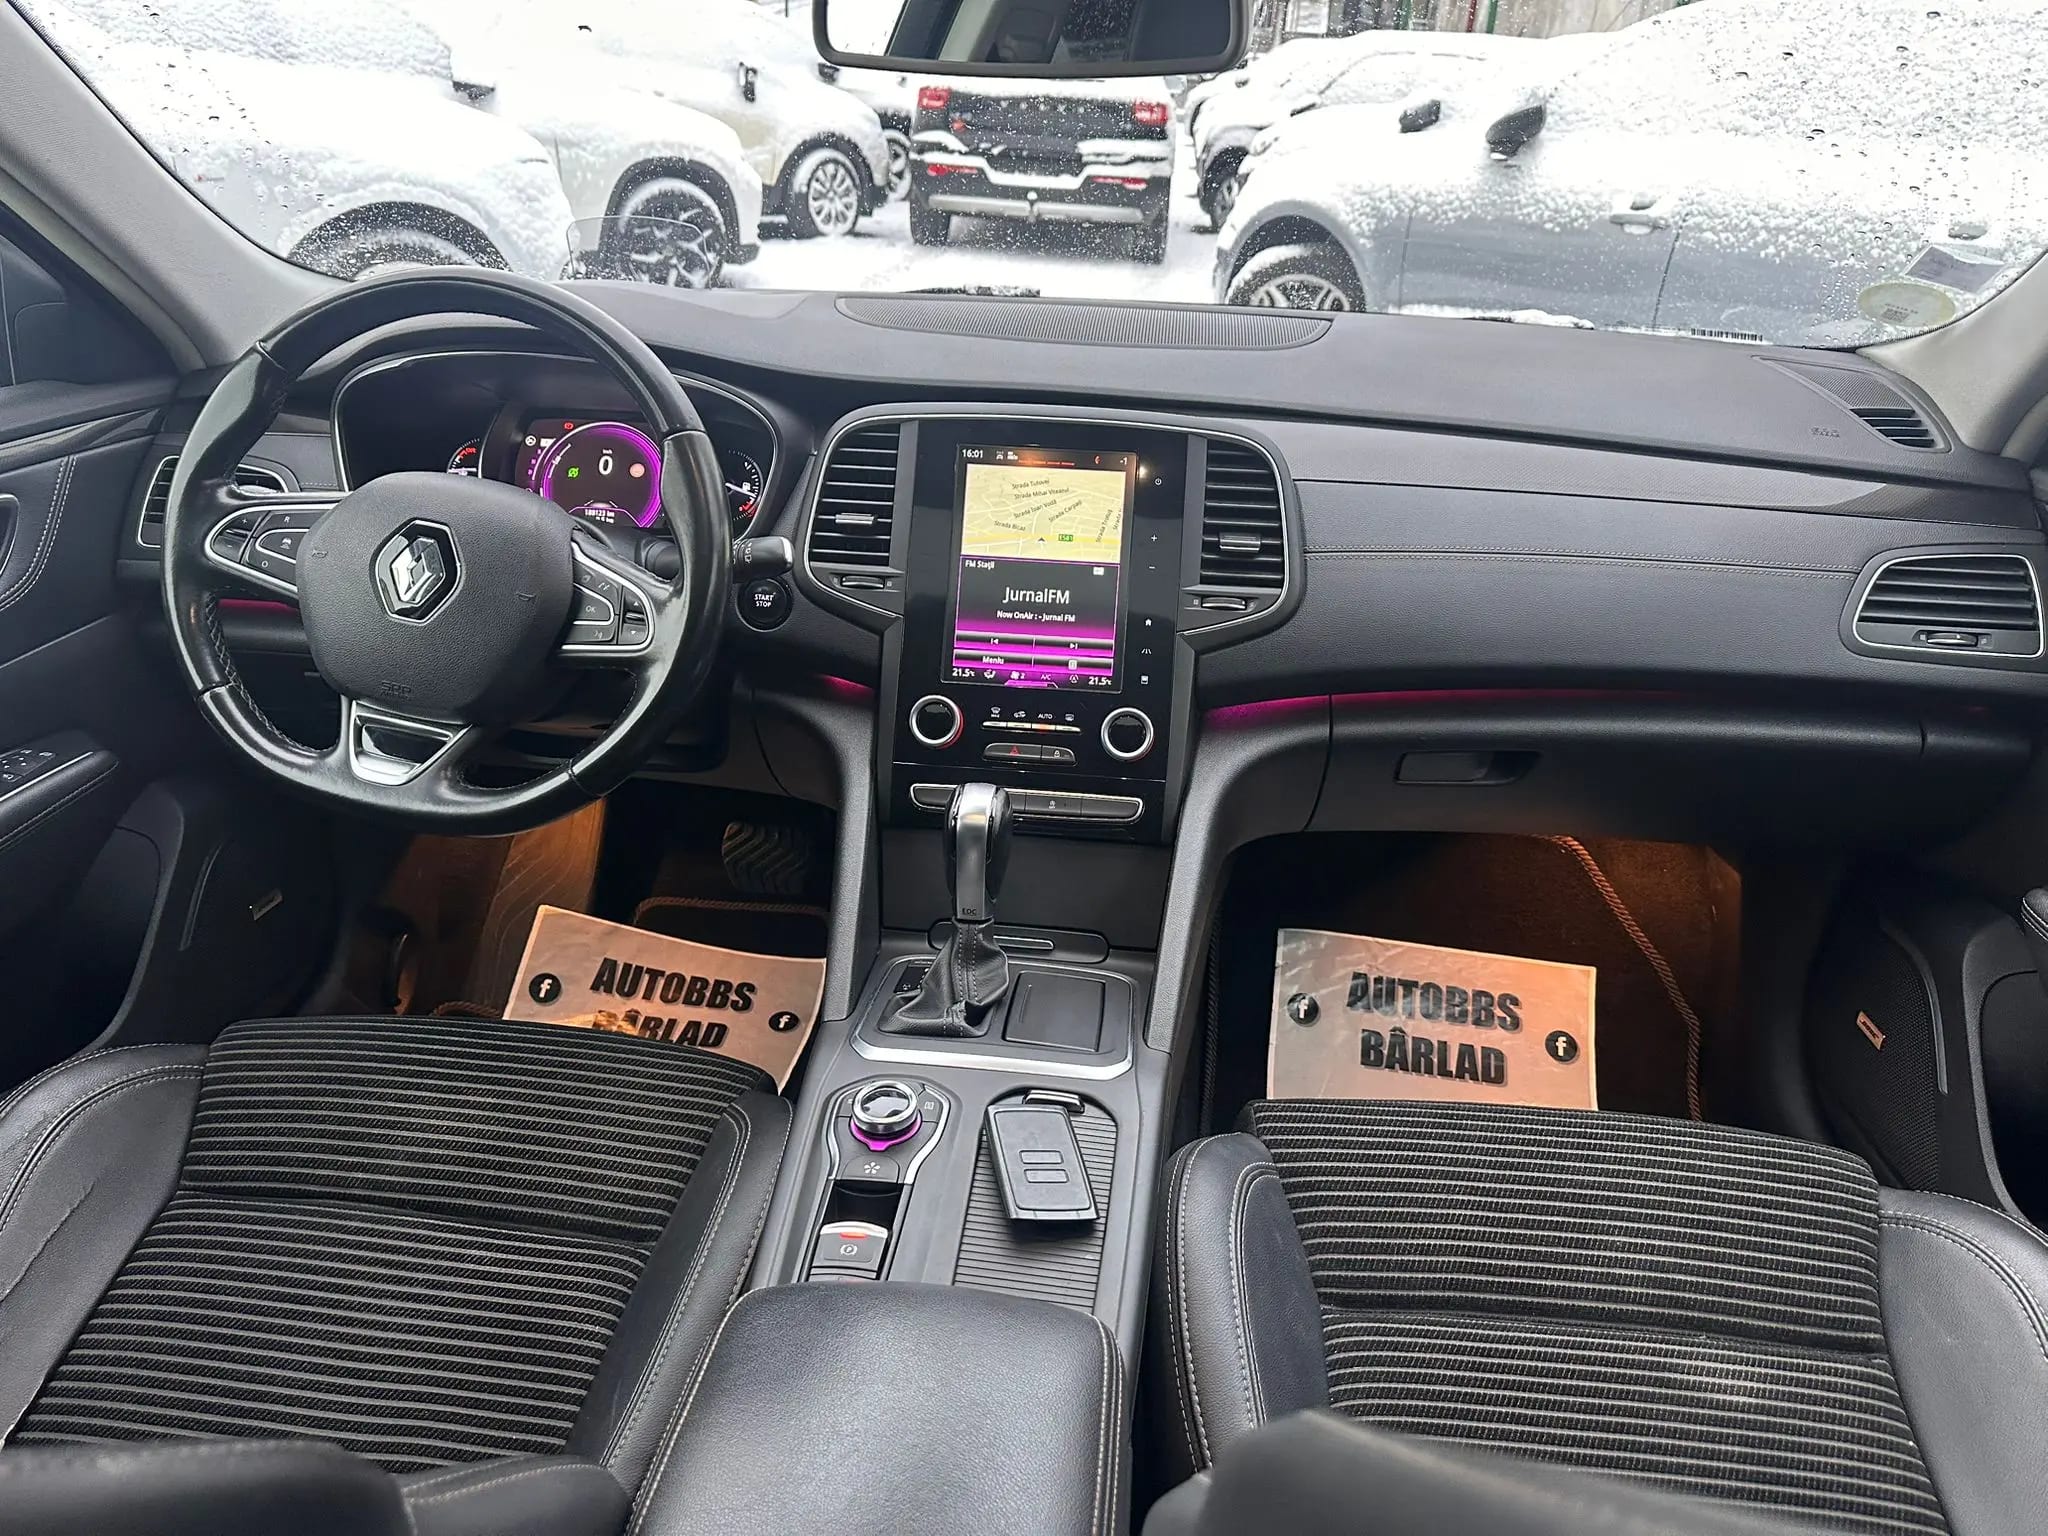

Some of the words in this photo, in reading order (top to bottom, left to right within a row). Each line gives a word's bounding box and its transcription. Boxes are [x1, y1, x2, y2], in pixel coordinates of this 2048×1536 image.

[962, 449, 984, 459] 16:01
[598, 455, 613, 475] 0
[964, 559, 976, 569] FM
[754, 593, 774, 602] START
[1002, 586, 1070, 605] JurnalFM
[755, 600, 772, 608] STOP
[996, 610, 1013, 620] Now
[1013, 611, 1034, 621] OnAir
[1063, 614, 1076, 623] FM
[982, 655, 1005, 665] Meniu
[1037, 712, 1053, 720] AUTO
[590, 957, 757, 1012] AUTOBBS
[1346, 971, 1522, 1032] AUTOBBS
[1360, 1026, 1508, 1086] BÂRLAD
